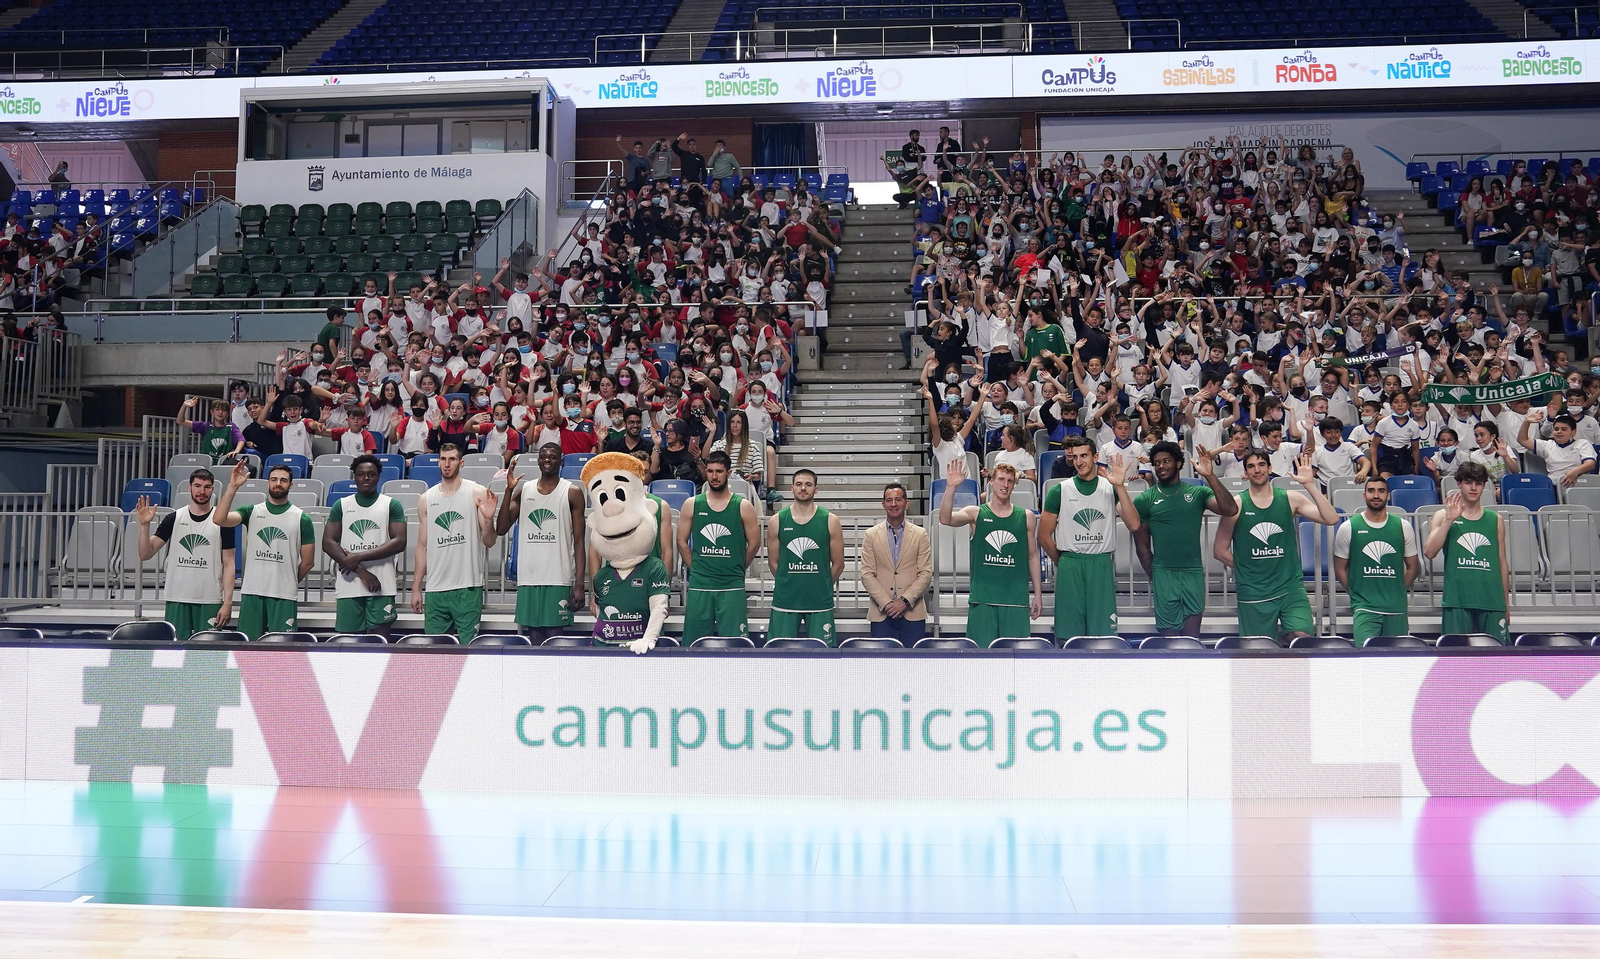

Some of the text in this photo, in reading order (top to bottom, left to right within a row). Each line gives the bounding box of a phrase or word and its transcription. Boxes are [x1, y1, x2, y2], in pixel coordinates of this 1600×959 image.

[1229, 123, 1332, 137] PALACIO DE DEPORTES
[331, 166, 473, 182] Ayuntamiento de Málaga
[1344, 351, 1389, 365] UNICAJA
[1475, 379, 1542, 400] Unicaja
[437, 532, 466, 545] Unicaja
[527, 532, 556, 541] Unicaja
[1074, 532, 1104, 542] Unicaja
[256, 550, 284, 561] Unicaja
[701, 545, 731, 556] Unicaja
[1251, 545, 1284, 556] Unicaja
[178, 556, 208, 567] Unicaja
[985, 553, 1015, 565] Unicaja
[1457, 556, 1490, 569] Unicaja
[788, 561, 818, 572] Unicaja
[1363, 565, 1396, 576] Unicaja
[617, 612, 643, 620] Unicaja
[515, 693, 1168, 769] campusunicaja.es
